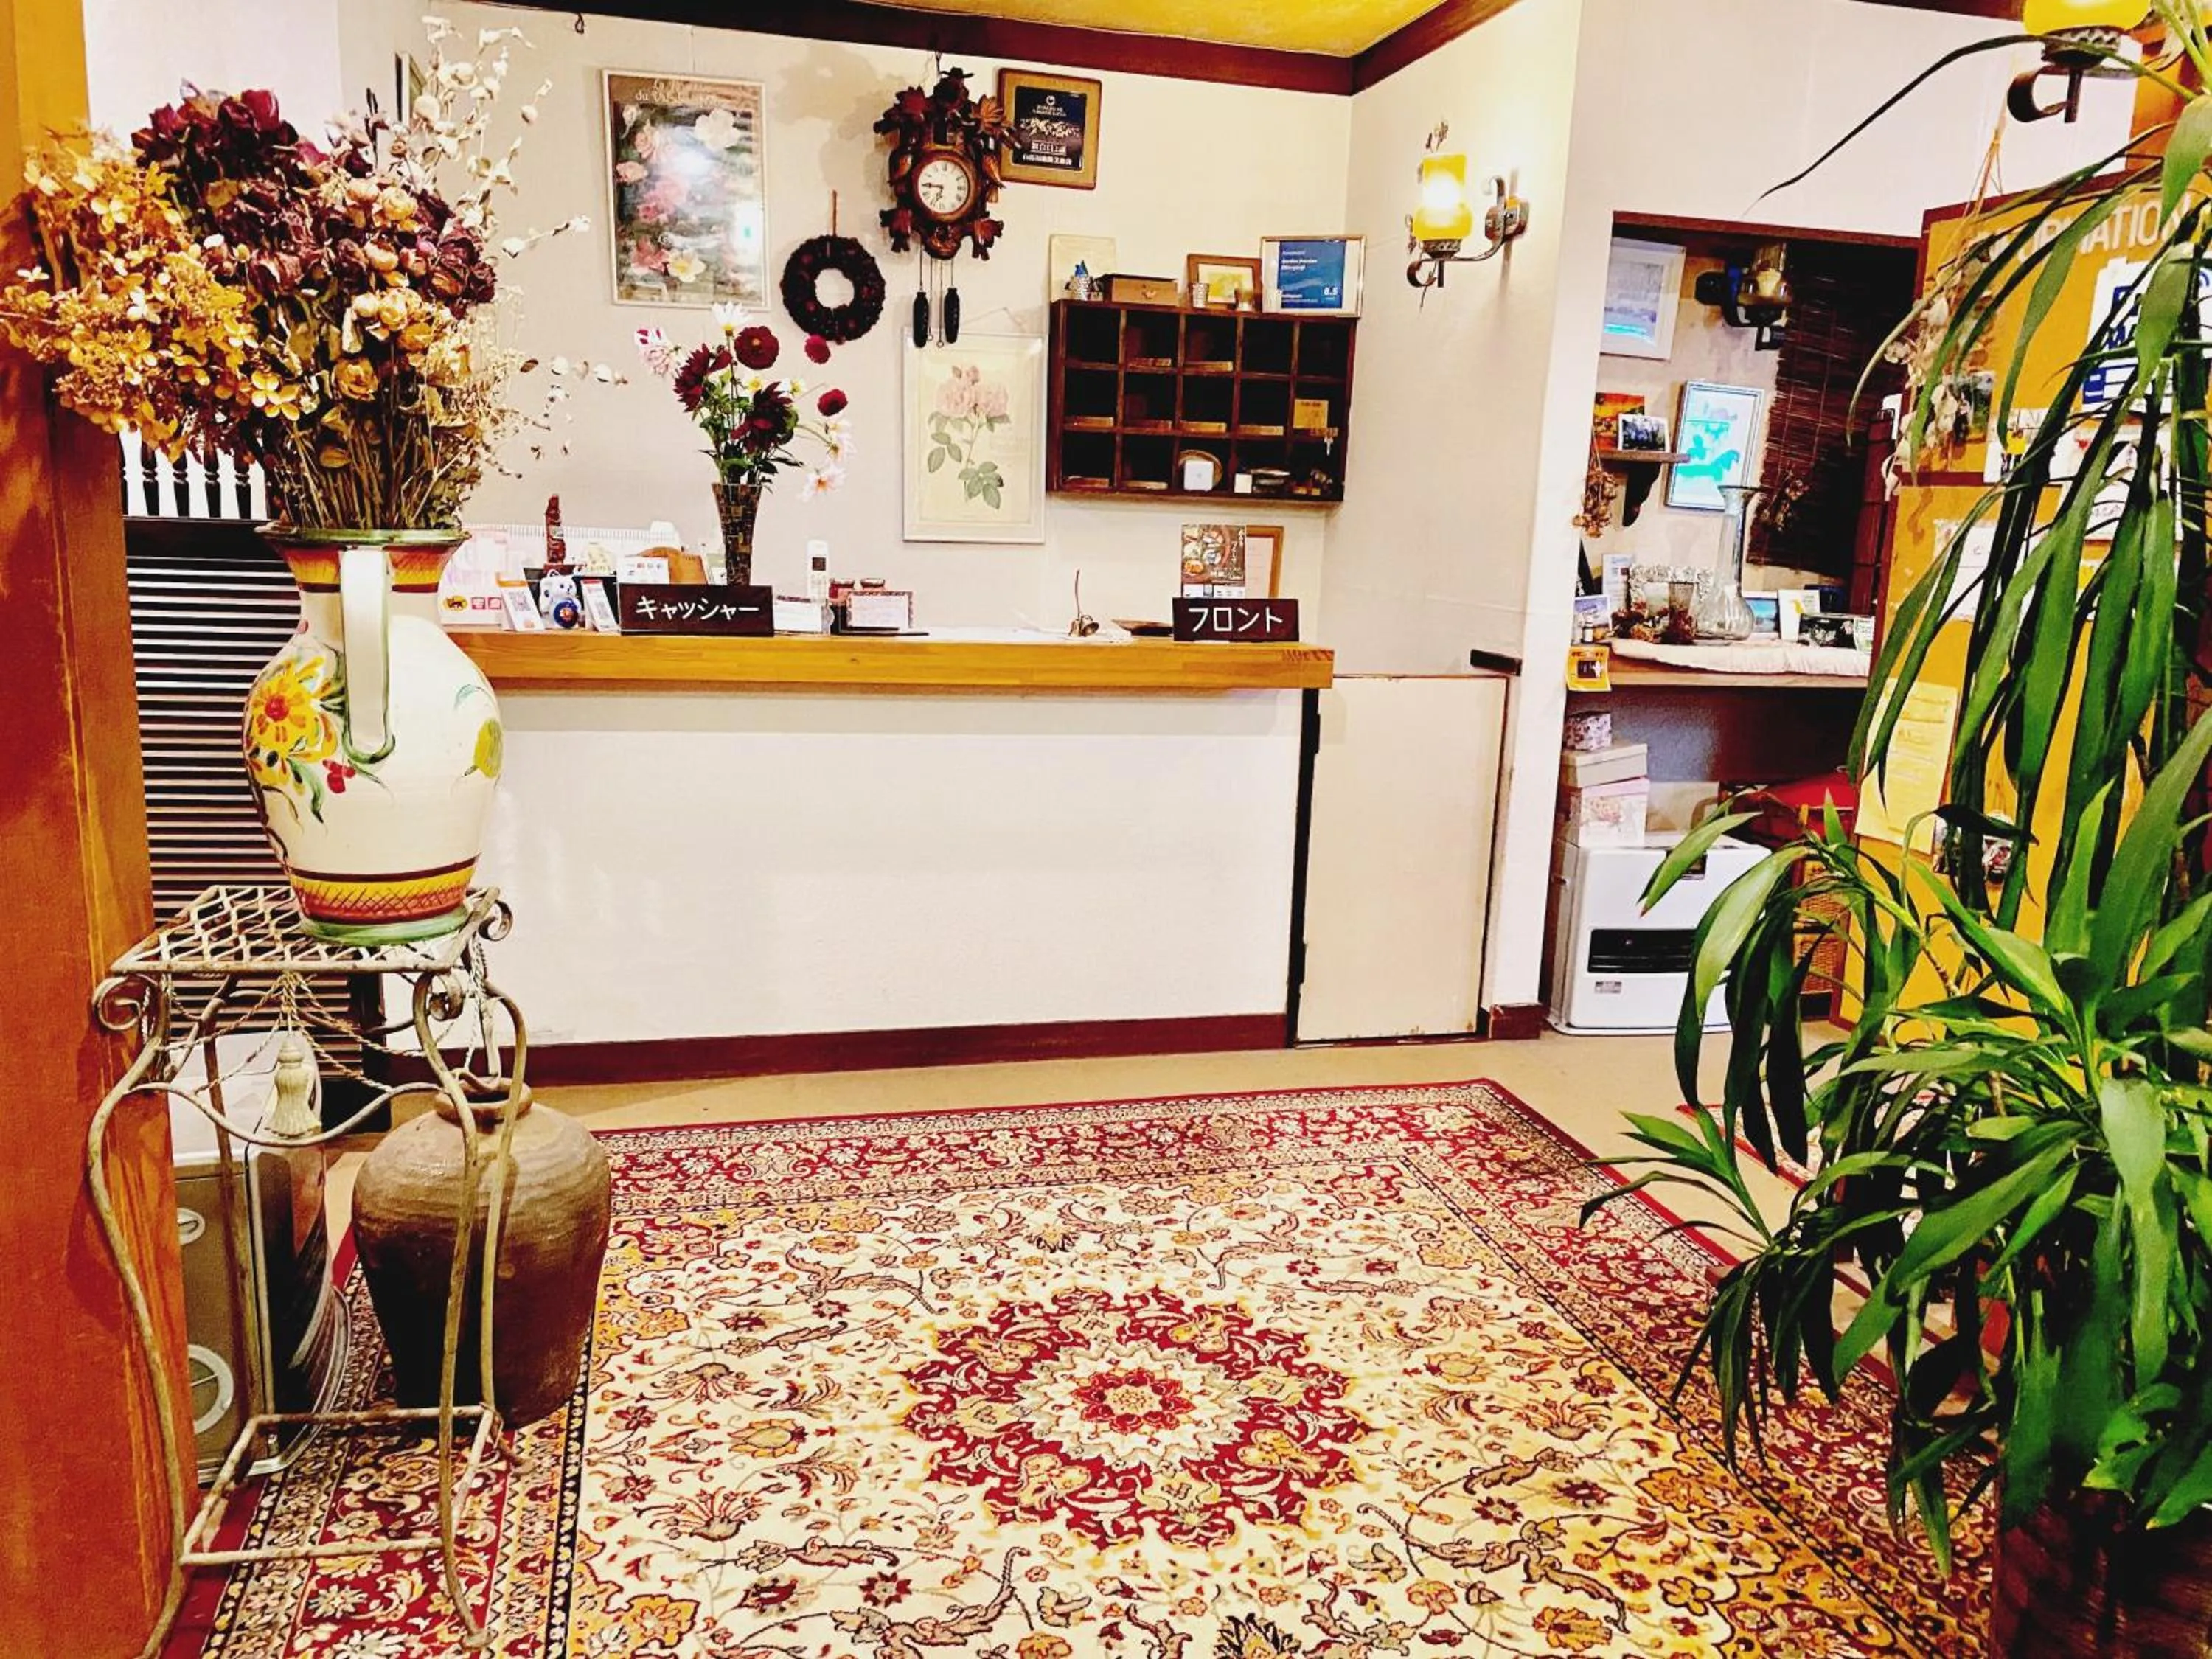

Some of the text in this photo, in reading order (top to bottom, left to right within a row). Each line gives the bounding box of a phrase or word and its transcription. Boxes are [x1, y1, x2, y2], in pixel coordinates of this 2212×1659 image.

[636, 596, 759, 621] キャッシャー
[1188, 606, 1284, 633] フロント
